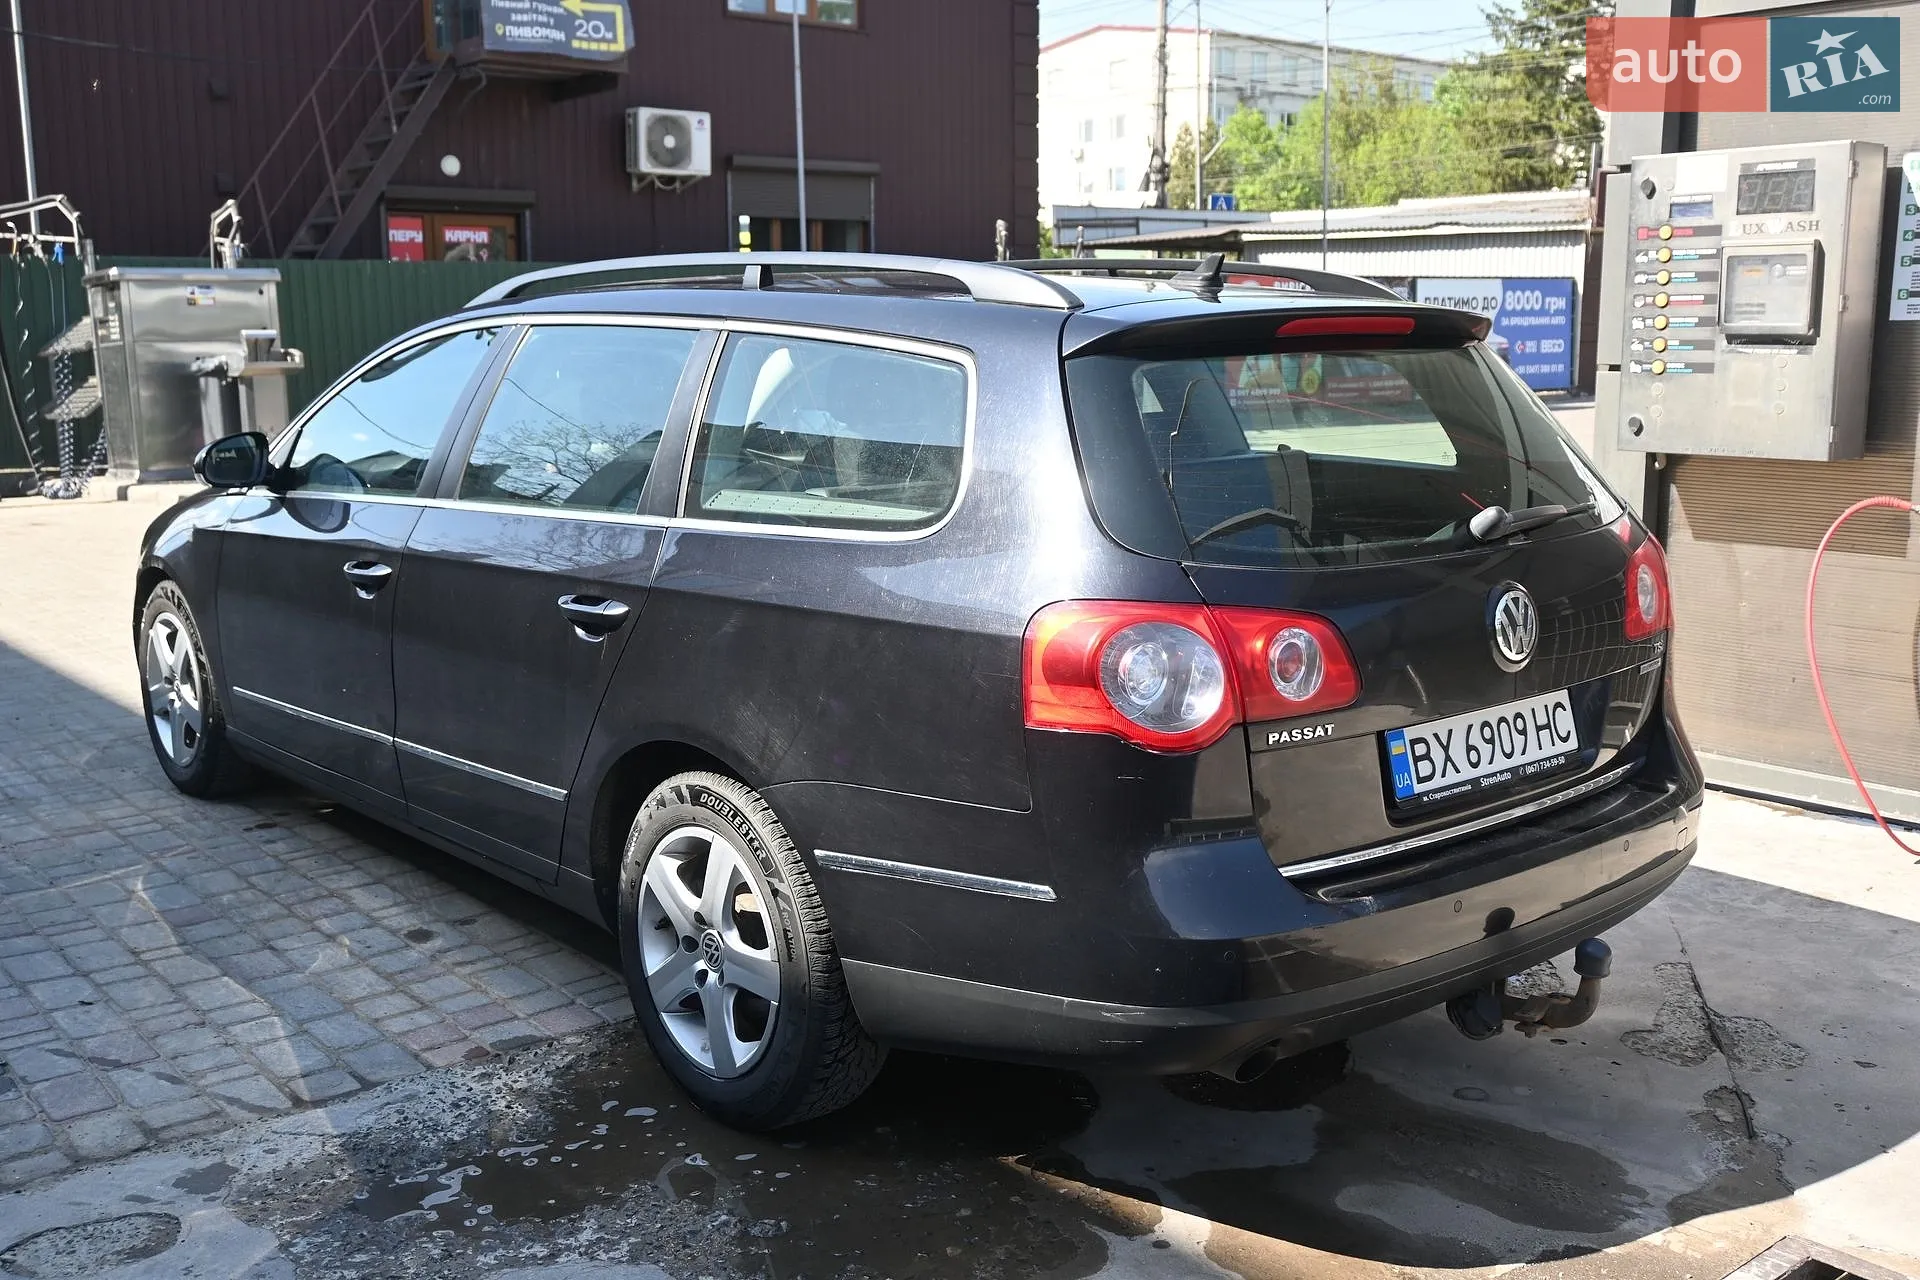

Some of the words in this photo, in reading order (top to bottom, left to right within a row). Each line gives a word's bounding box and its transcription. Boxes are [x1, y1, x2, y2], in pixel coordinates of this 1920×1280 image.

[1482, 297, 1498, 313] ДО
[1505, 290, 1543, 311] 8000
[1545, 296, 1567, 314] грн
[1268, 723, 1335, 745] PASSAT
[1409, 728, 1462, 785] BX
[1465, 712, 1528, 769] 6909
[1531, 701, 1571, 751] HC
[1525, 762, 1540, 776] (067)
[1540, 755, 1566, 770] 734-59-50
[1396, 772, 1412, 788] UA
[1480, 771, 1512, 787] StrenAuto
